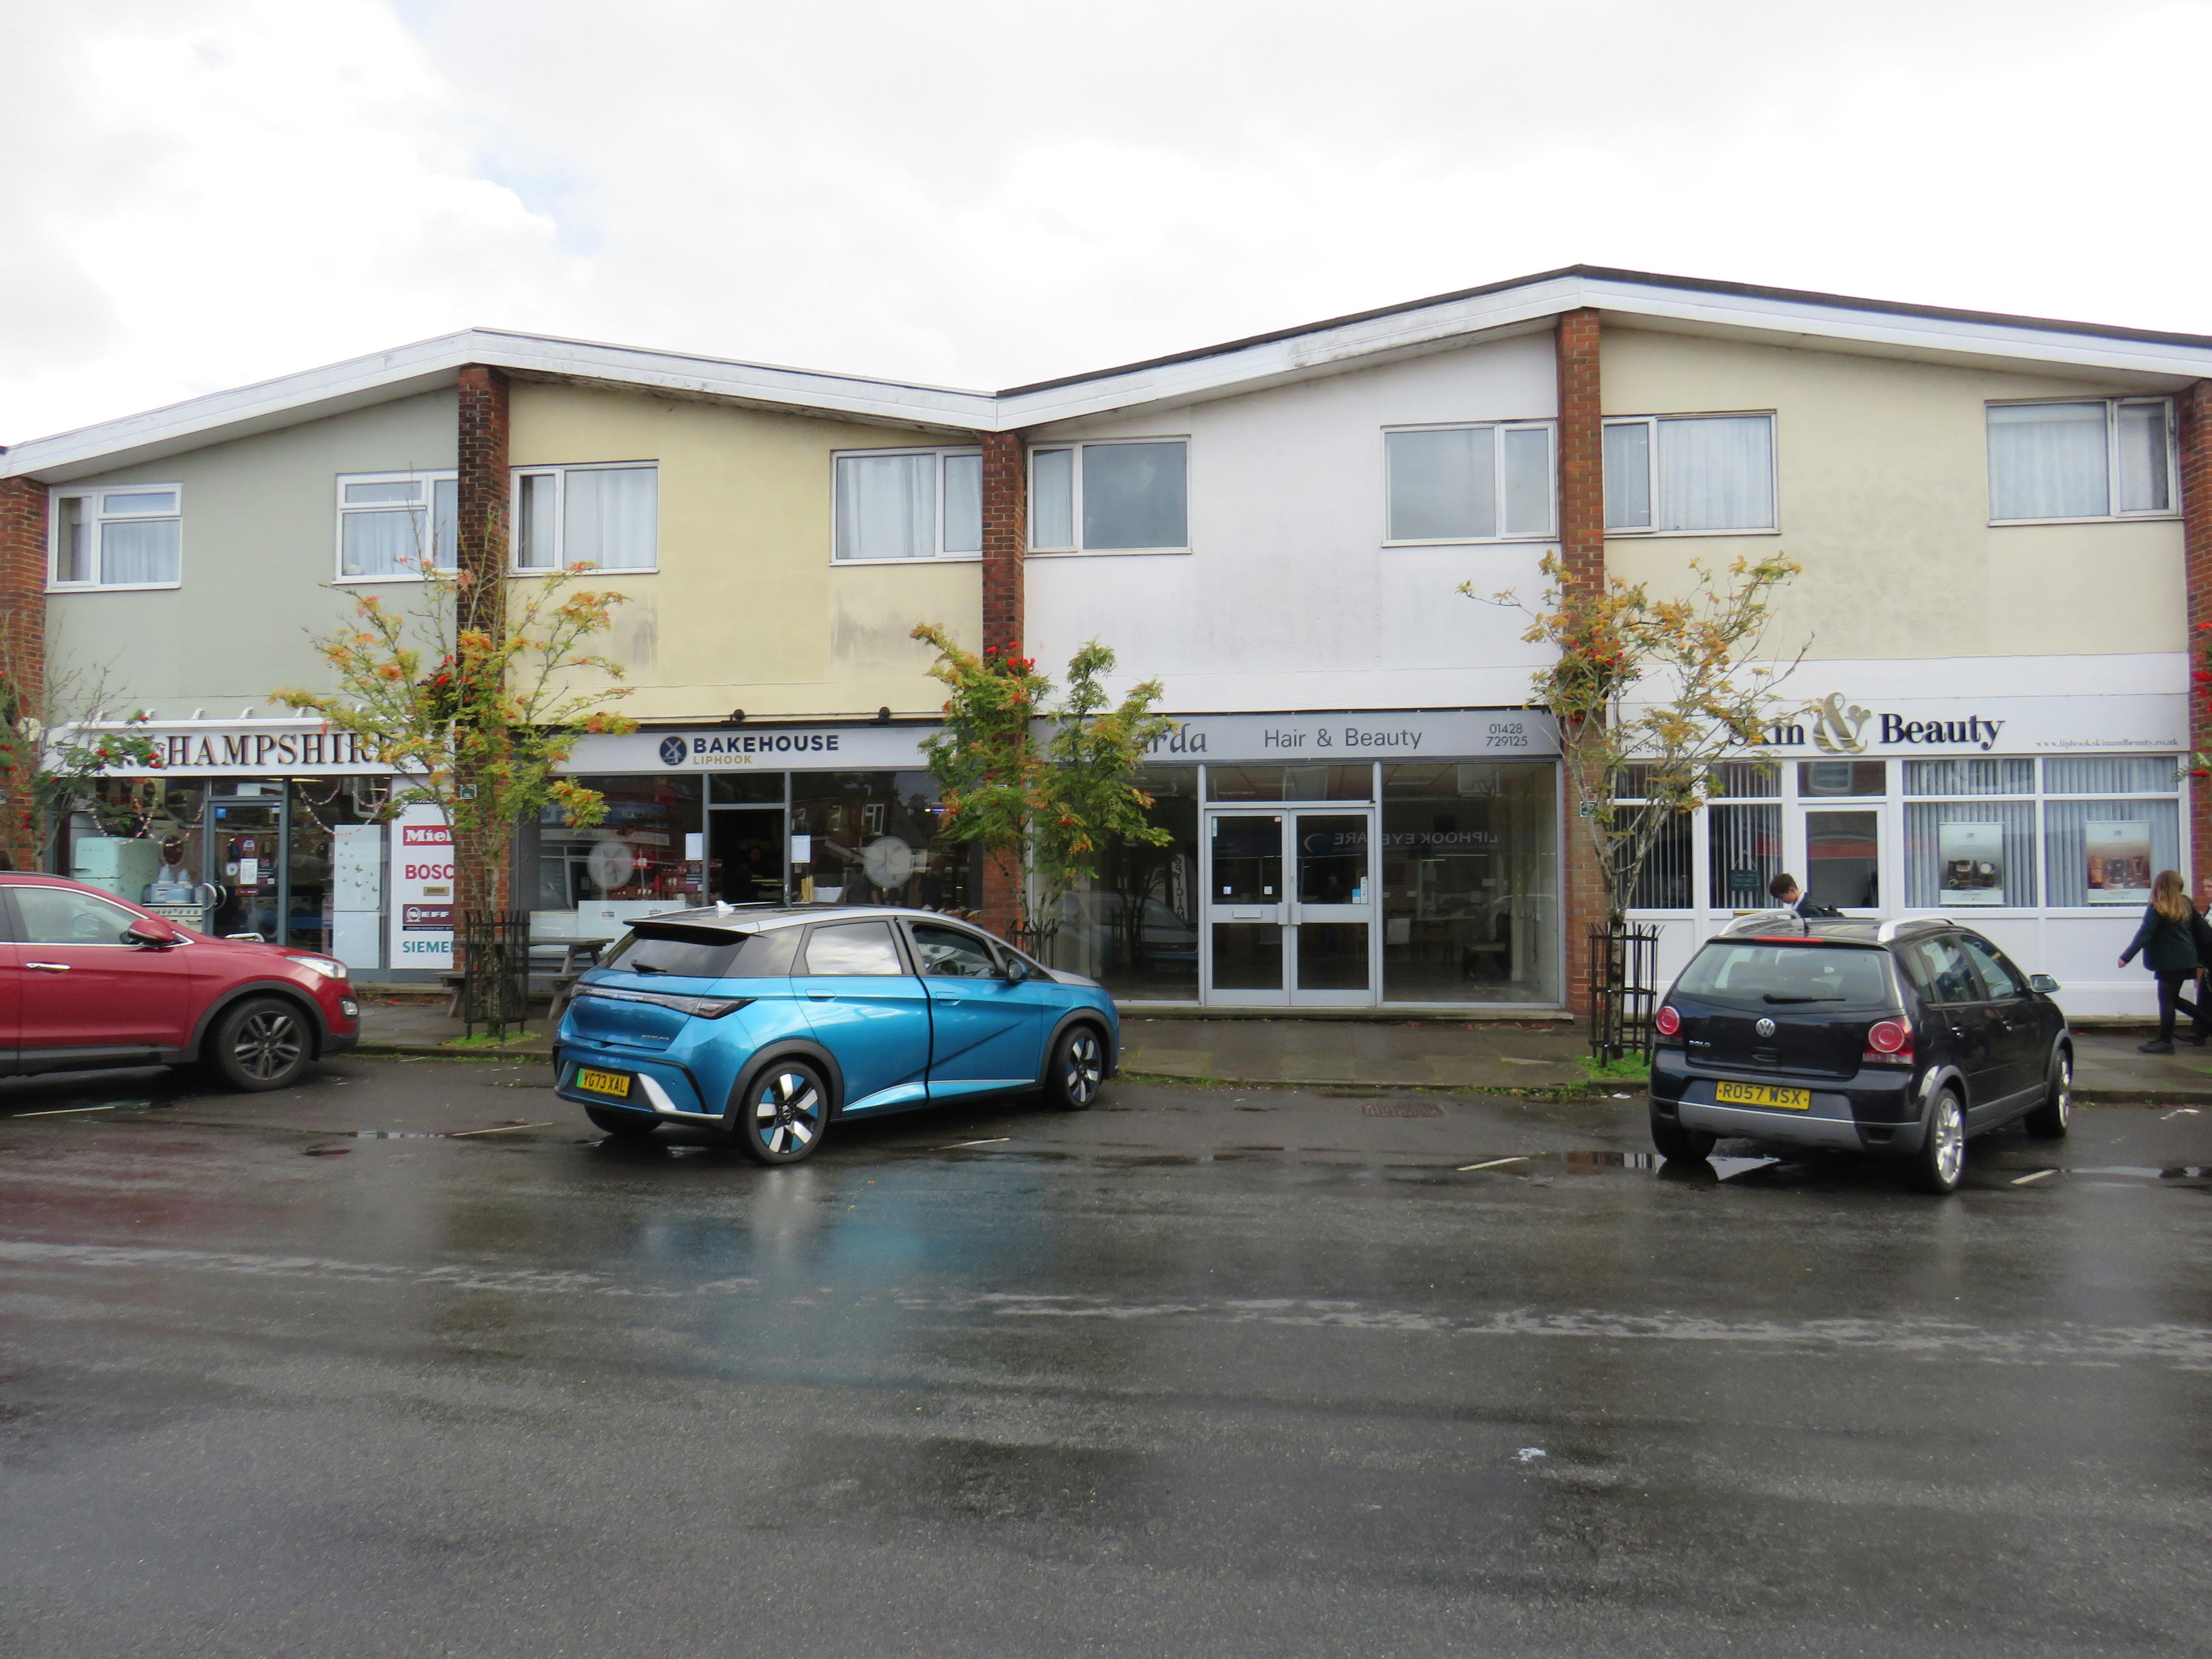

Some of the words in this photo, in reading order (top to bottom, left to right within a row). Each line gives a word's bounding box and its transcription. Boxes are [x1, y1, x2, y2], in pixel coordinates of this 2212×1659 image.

[1489, 723, 1522, 734] 01428
[1813, 692, 1872, 754] &
[1878, 713, 2005, 750] Beauty
[693, 735, 839, 754] BAKEHOUSE
[1264, 729, 1306, 748] Hair
[1317, 728, 1333, 747] &
[1345, 728, 1423, 750] Beauty
[1486, 736, 1527, 747] 729125
[693, 755, 751, 765] LIPHOOK
[405, 829, 453, 842] Miel
[405, 864, 454, 880] BOSC
[402, 941, 454, 953] SIEME
[583, 1071, 607, 1089] YG73
[607, 1075, 625, 1093] XAL
[1723, 1083, 1764, 1101] RO57
[1769, 1087, 1802, 1105] WSX
